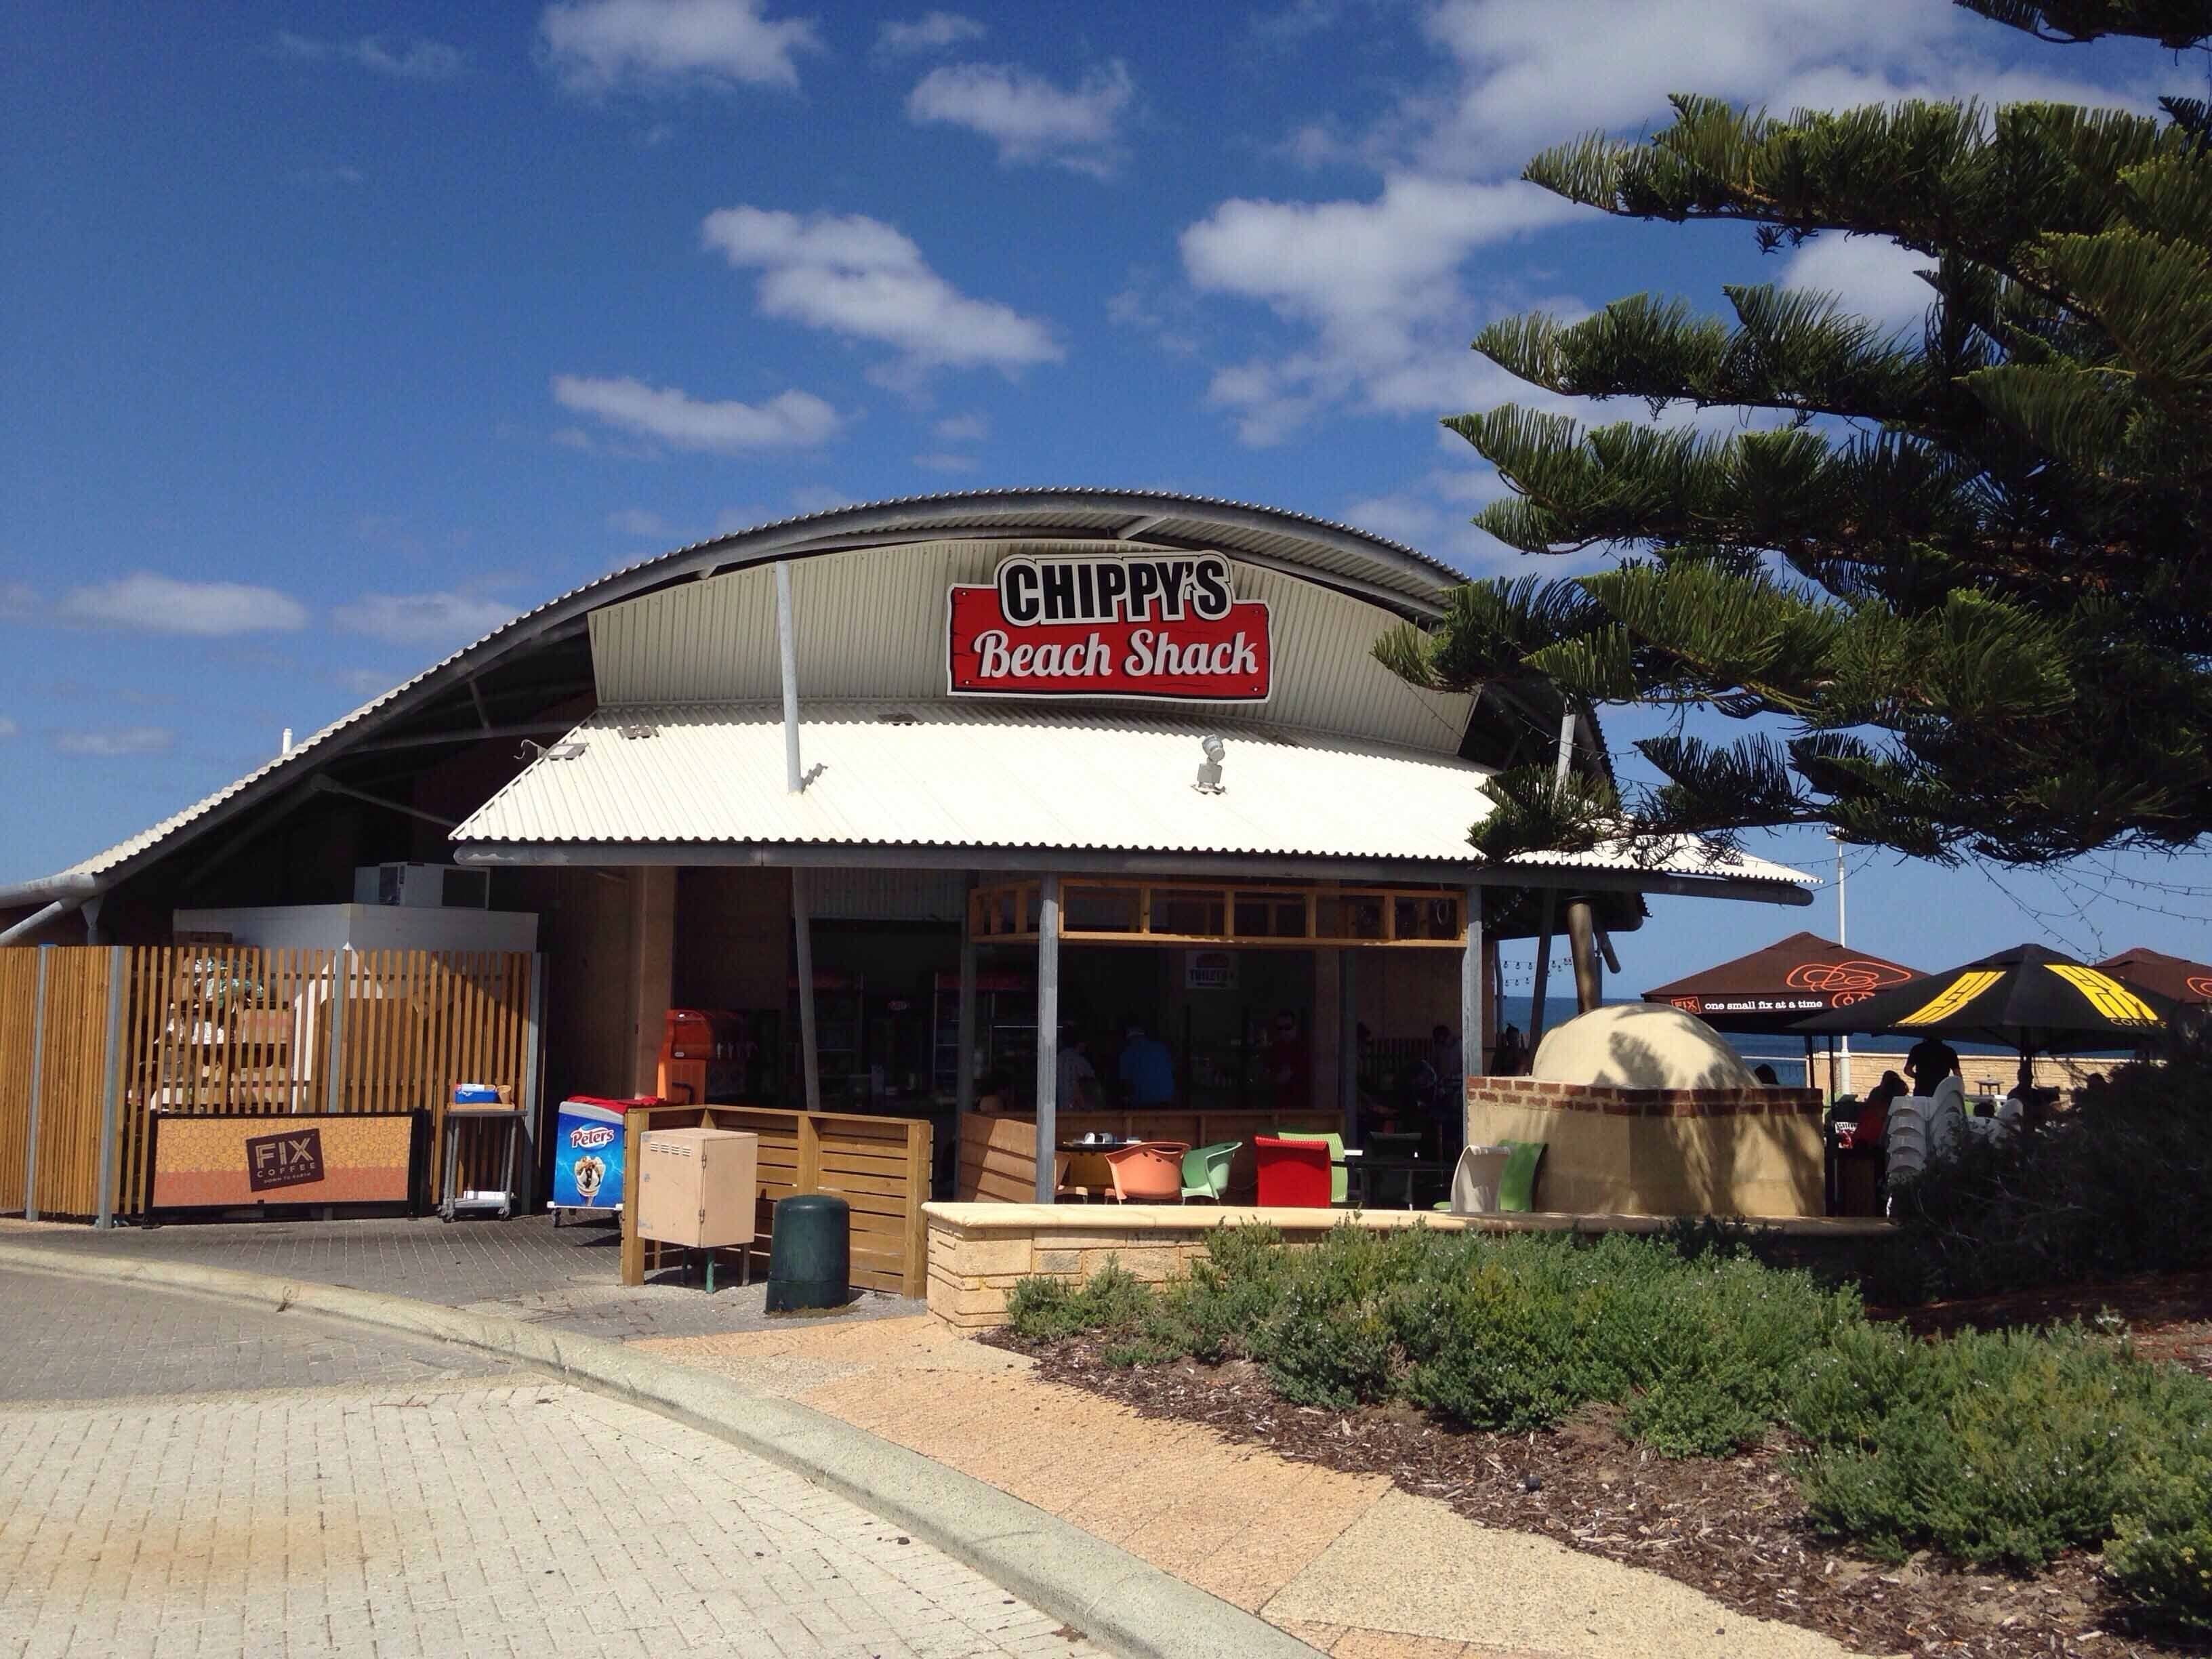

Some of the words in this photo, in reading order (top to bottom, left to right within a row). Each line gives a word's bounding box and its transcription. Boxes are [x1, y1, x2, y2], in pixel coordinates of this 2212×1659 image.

[1005, 558, 1228, 621] CHIPPY'S
[975, 629, 1112, 678] Beach
[1125, 628, 1259, 676] Shack
[1727, 1001, 1757, 1010] small
[1758, 1000, 1774, 1009] fix
[1775, 1001, 1786, 1009] at
[1788, 1000, 1796, 1009] a
[1797, 1000, 1823, 1008] time
[571, 1128, 614, 1147] Peters
[255, 1137, 314, 1169] FIX
[257, 1162, 316, 1178] COFFEE
